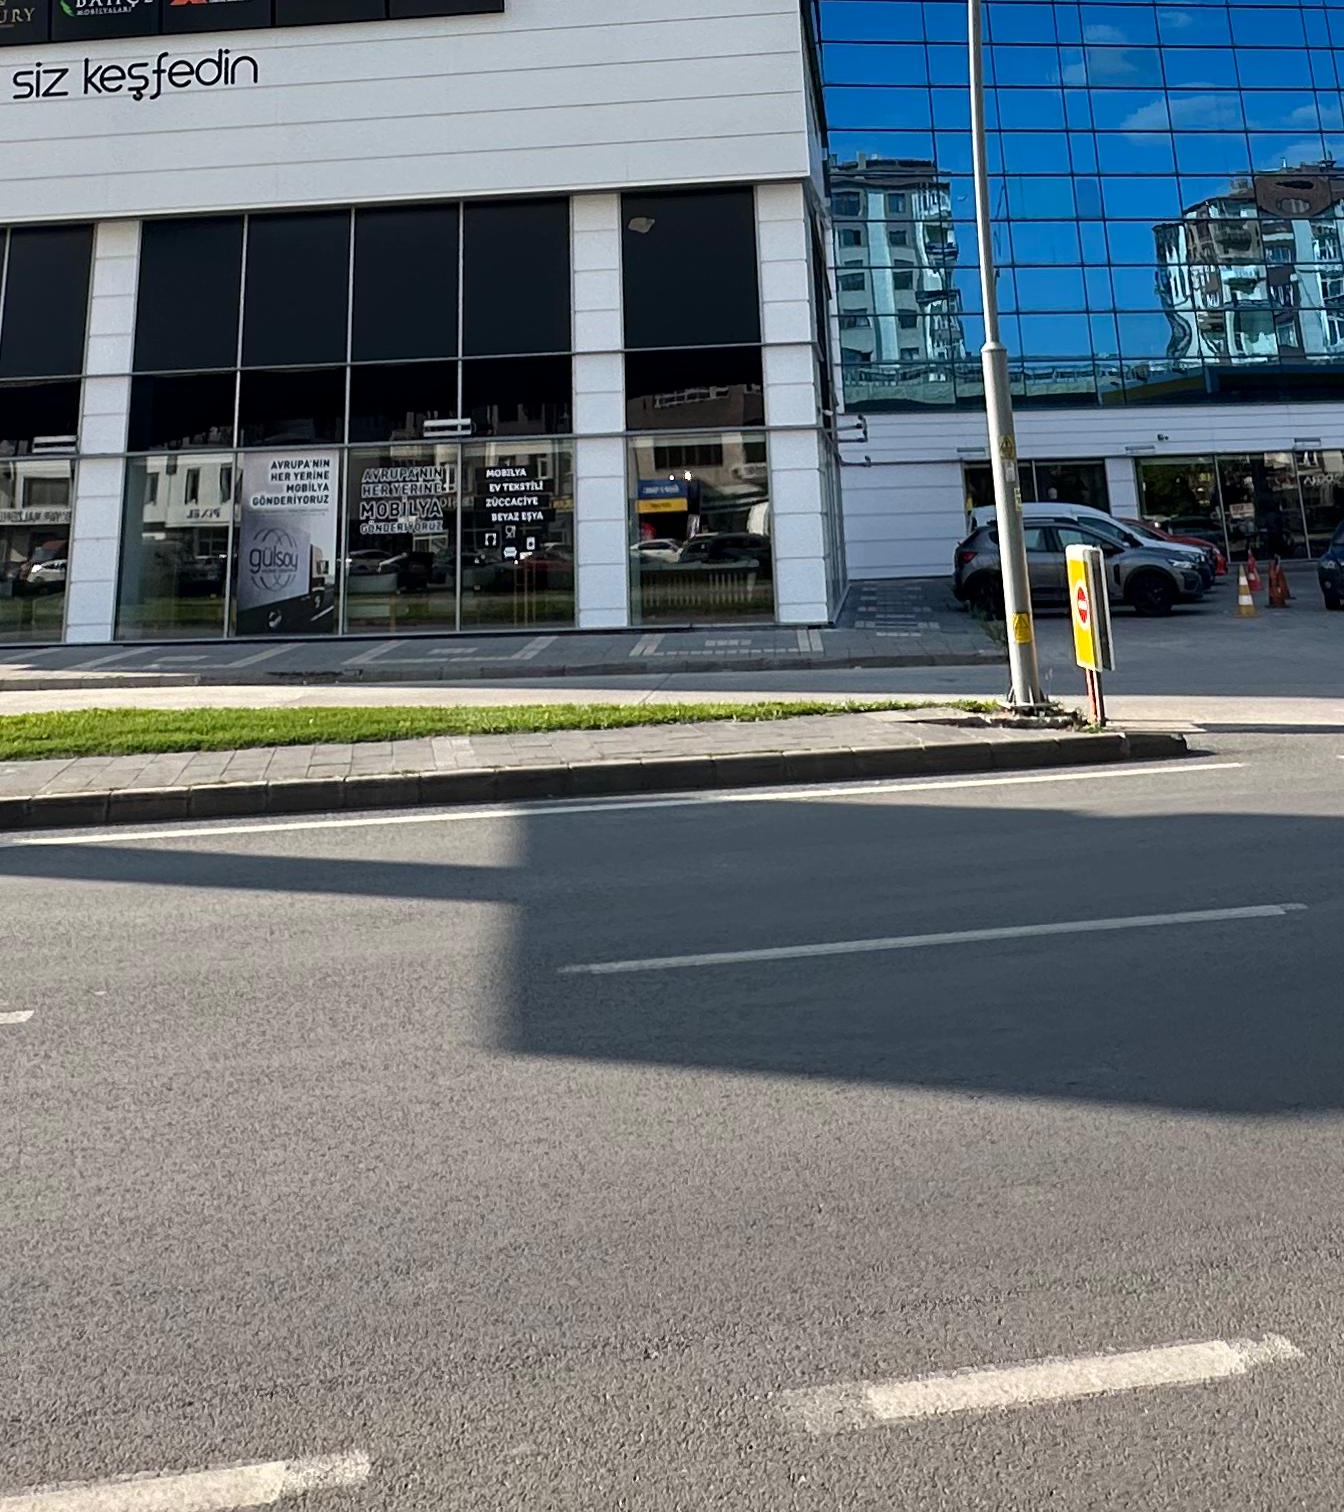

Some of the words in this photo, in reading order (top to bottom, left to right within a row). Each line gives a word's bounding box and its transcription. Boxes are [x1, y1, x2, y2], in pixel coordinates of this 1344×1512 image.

[12, 61, 69, 100] siz
[83, 48, 258, 101] keşfedin
[271, 459, 330, 470] AVRUPA'NIN
[271, 471, 290, 482] HER
[294, 470, 330, 481] YERİNE
[286, 482, 329, 494] MOBİLYA
[362, 482, 389, 498] HER
[489, 483, 501, 493] EV
[503, 480, 544, 492] TEKSTİLİ
[252, 494, 329, 506] GÖNDERİYORUZ
[485, 495, 538, 508] ZÜCCACİYE
[360, 495, 444, 520] MOBİLYA
[491, 512, 519, 522] BEYAZ
[522, 511, 543, 523] EŞYA
[249, 545, 298, 574] gülsoy
